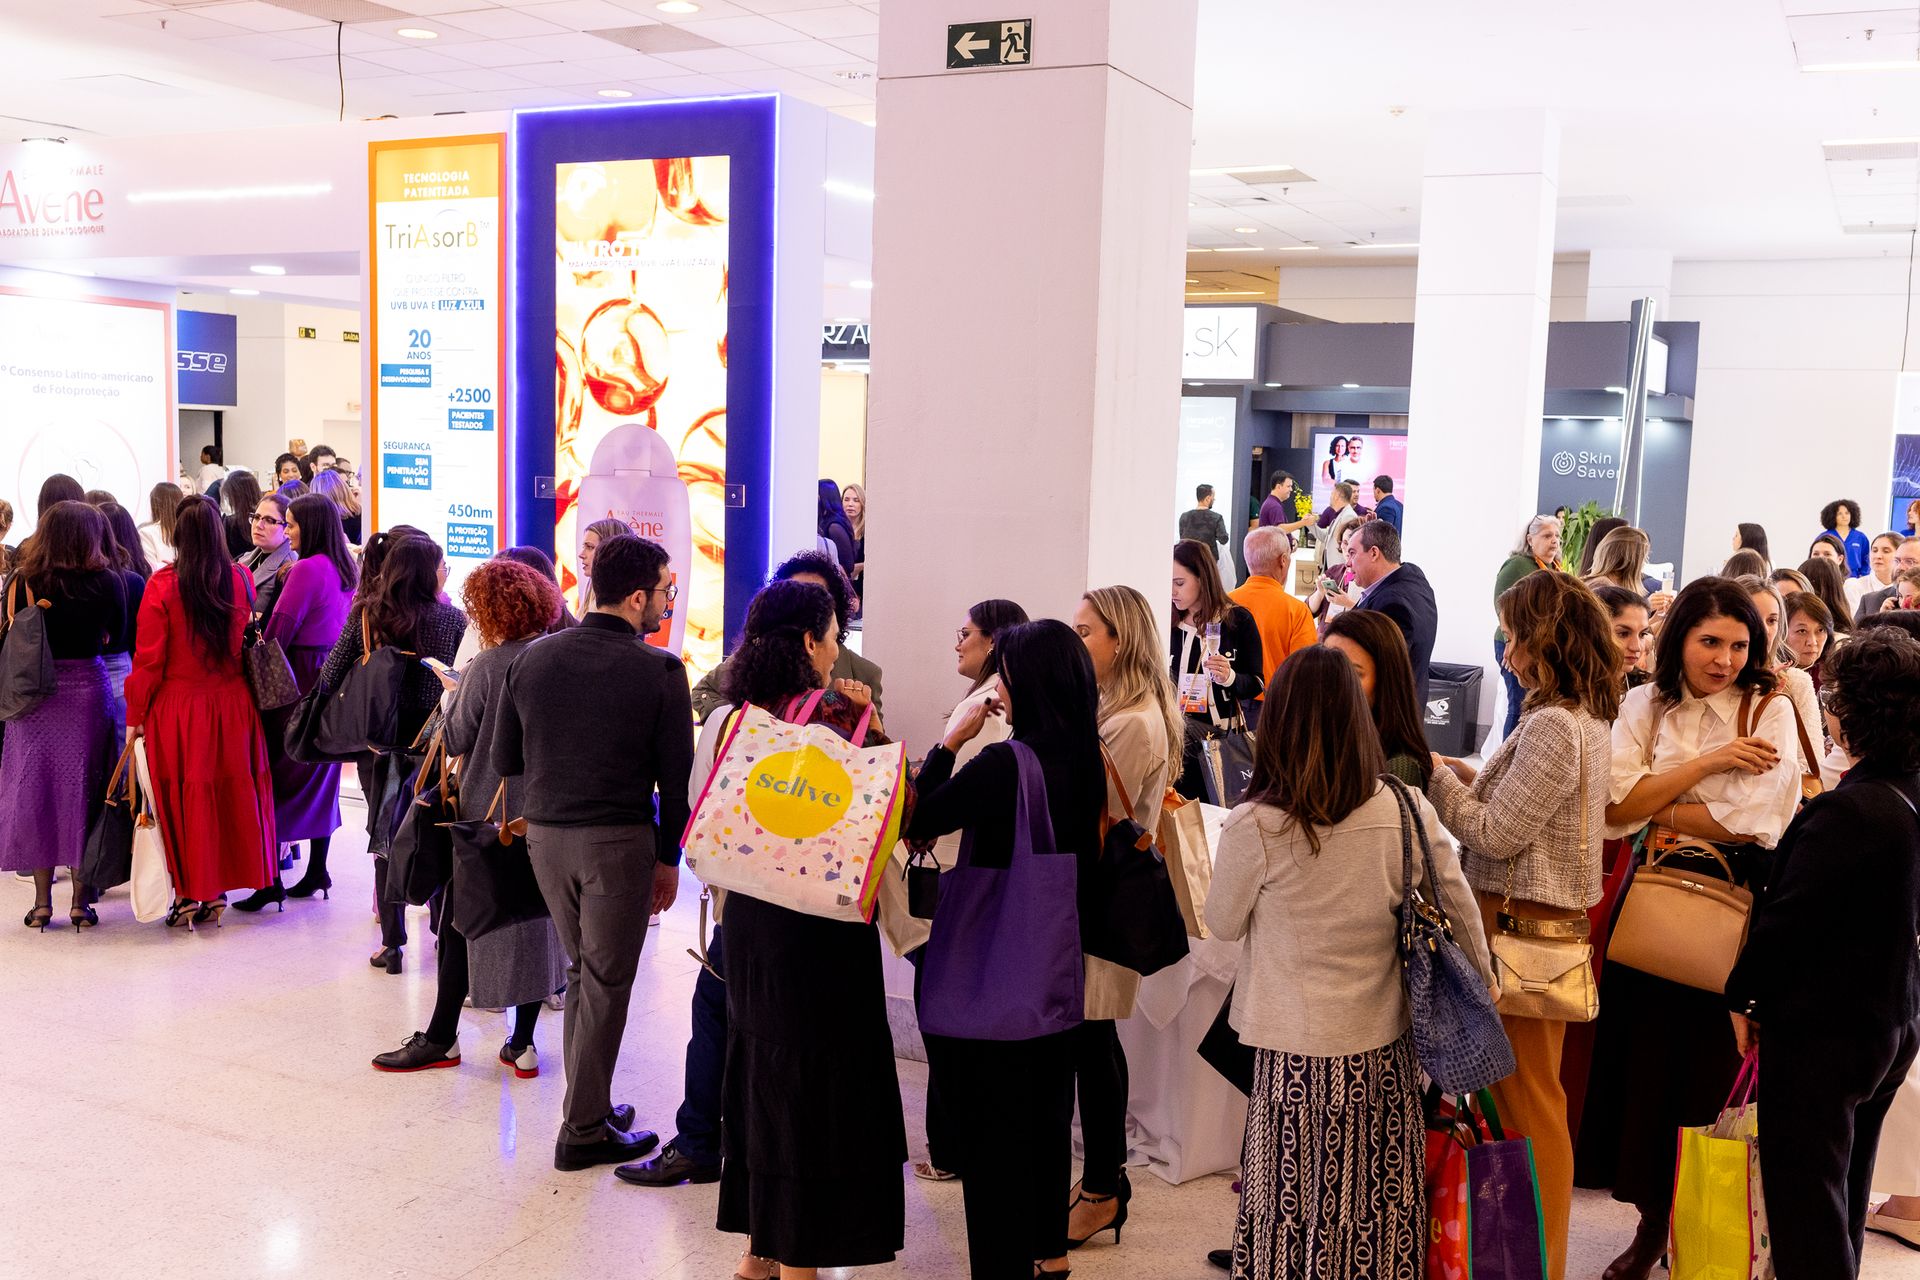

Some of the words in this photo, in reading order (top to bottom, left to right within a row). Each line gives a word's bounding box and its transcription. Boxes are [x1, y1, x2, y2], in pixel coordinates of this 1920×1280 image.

[403, 170, 470, 184] TECNOLOGIA
[403, 185, 470, 198] PATENTEADA
[390, 301, 408, 310] UVB
[411, 301, 428, 310] UVA
[432, 301, 435, 309] E
[408, 329, 431, 348] 20
[406, 351, 431, 360] ANOS
[9, 366, 62, 378] Consenso
[65, 369, 153, 383] Latino-americano
[32, 384, 47, 393] de
[49, 384, 120, 398] Fotoproteção
[448, 388, 491, 403] +2500
[451, 411, 484, 420] PACIENTES
[451, 420, 484, 429] TESTADOS
[383, 441, 431, 451] SEGURANÇA
[414, 457, 429, 466] SEM
[1578, 451, 1612, 465] Skin
[386, 465, 429, 476] PENETRAÇÃO
[402, 477, 414, 485] NA
[415, 478, 429, 486] PELE
[448, 504, 493, 518] 450nm
[448, 526, 454, 534] A
[454, 525, 488, 537] PROTEÇÃO
[448, 535, 464, 543] MAIS
[465, 536, 488, 546] AMPLA
[448, 544, 459, 552] DO
[459, 545, 491, 555] MERCADO
[755, 773, 841, 807] sallve
